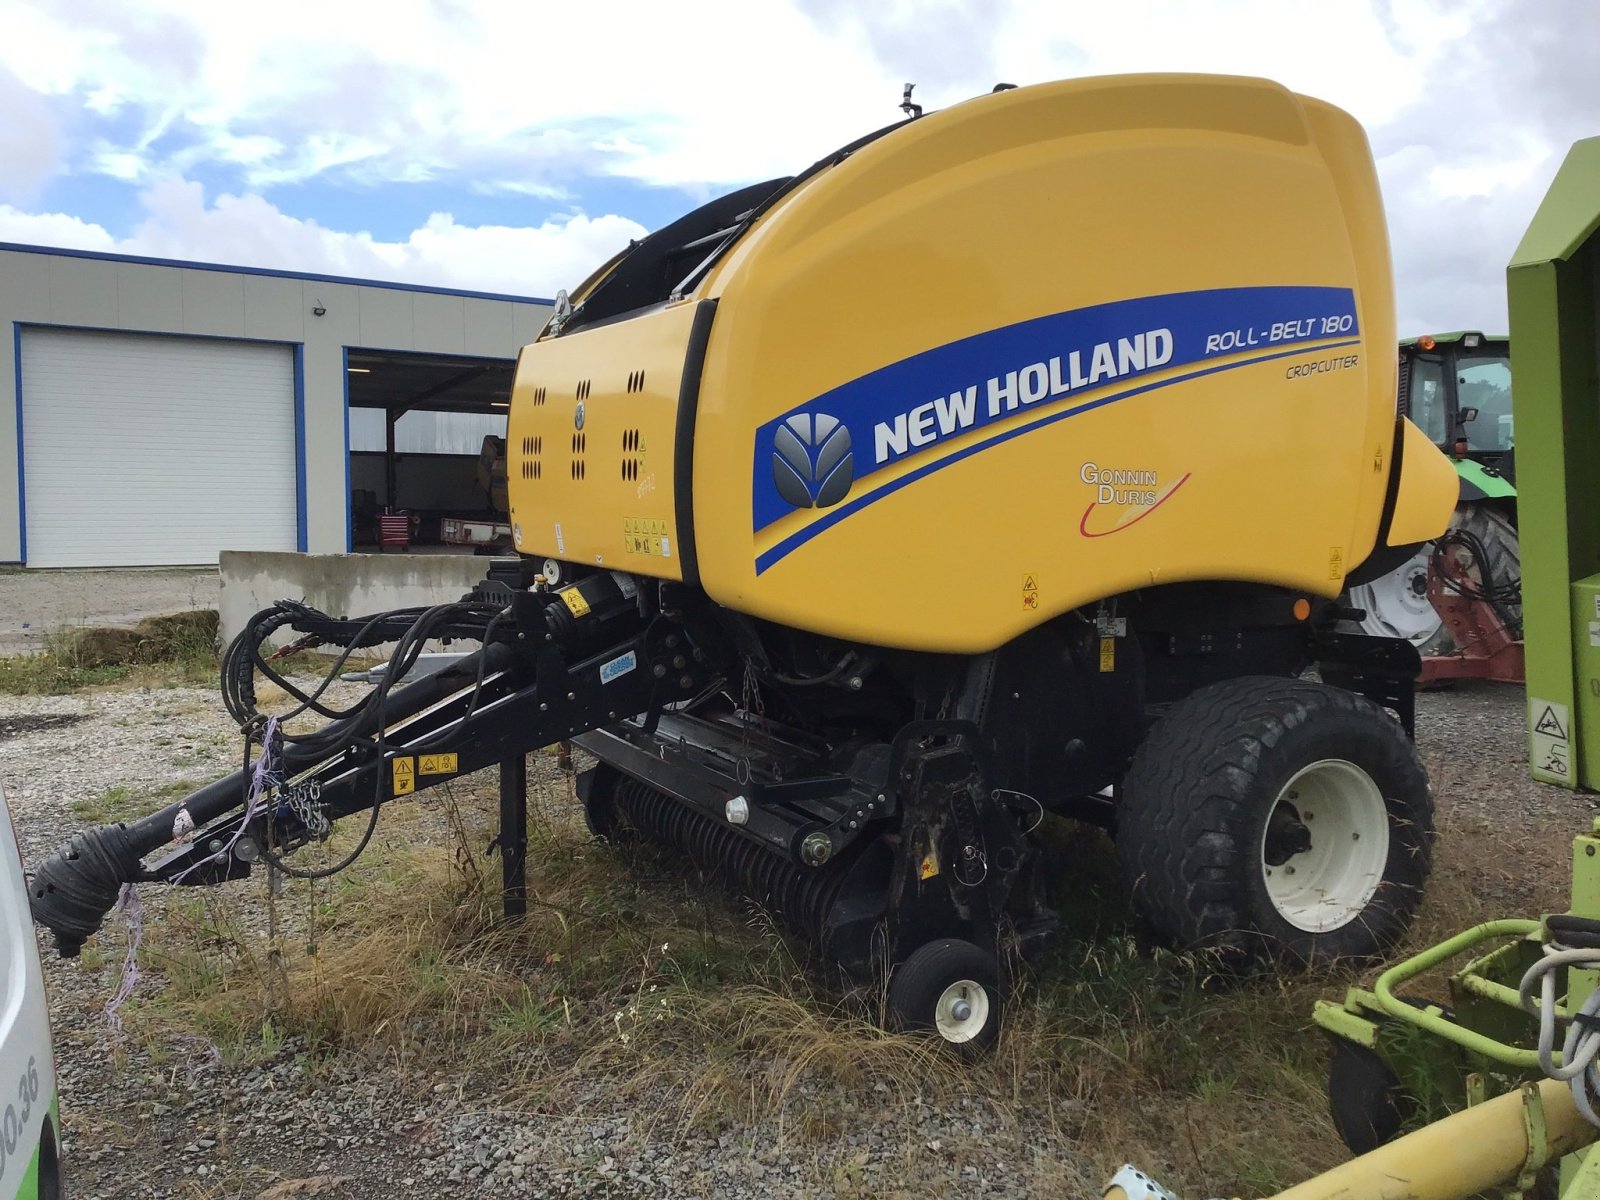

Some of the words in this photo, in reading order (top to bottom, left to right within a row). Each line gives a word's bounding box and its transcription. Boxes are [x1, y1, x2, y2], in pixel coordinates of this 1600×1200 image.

[1205, 318, 1316, 354] ROLL-BELT
[1321, 314, 1353, 335] 180
[1286, 355, 1359, 380] CROPCUTTER
[874, 385, 978, 465] NEW
[987, 328, 1174, 417] HOLLAND
